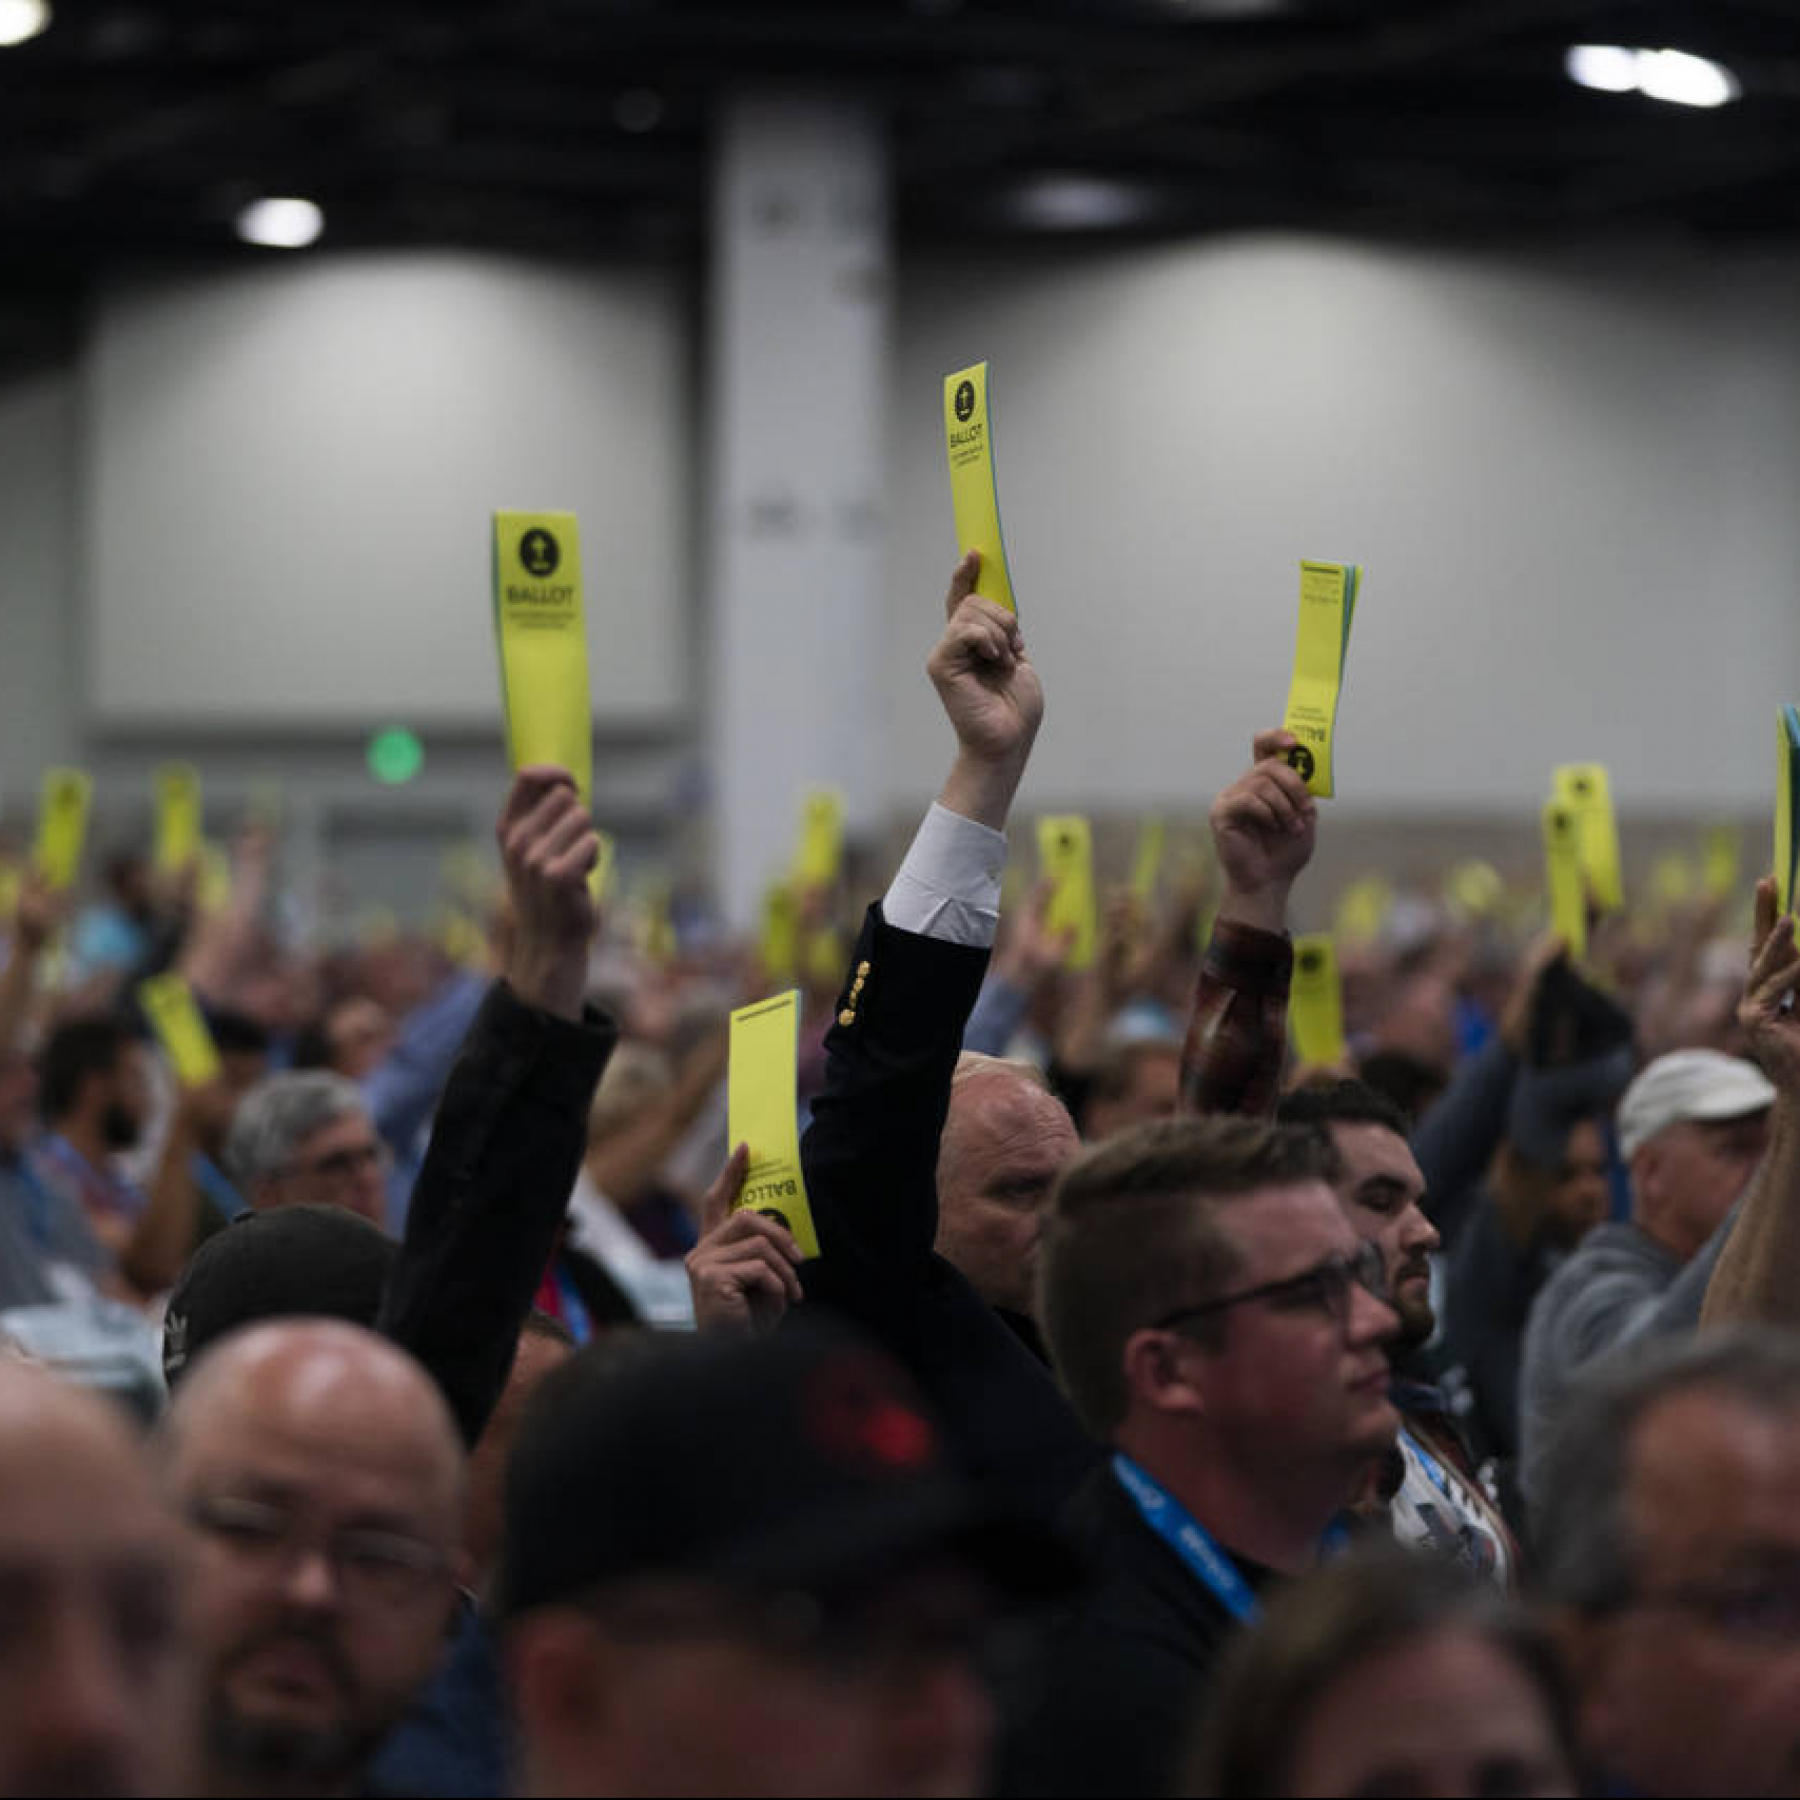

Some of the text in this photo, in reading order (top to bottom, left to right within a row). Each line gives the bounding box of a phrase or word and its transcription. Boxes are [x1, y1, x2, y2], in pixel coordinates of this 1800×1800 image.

[950, 424, 982, 448] BALLOT
[507, 586, 573, 605] BALLOT
[744, 1179, 798, 1203] BALLO
